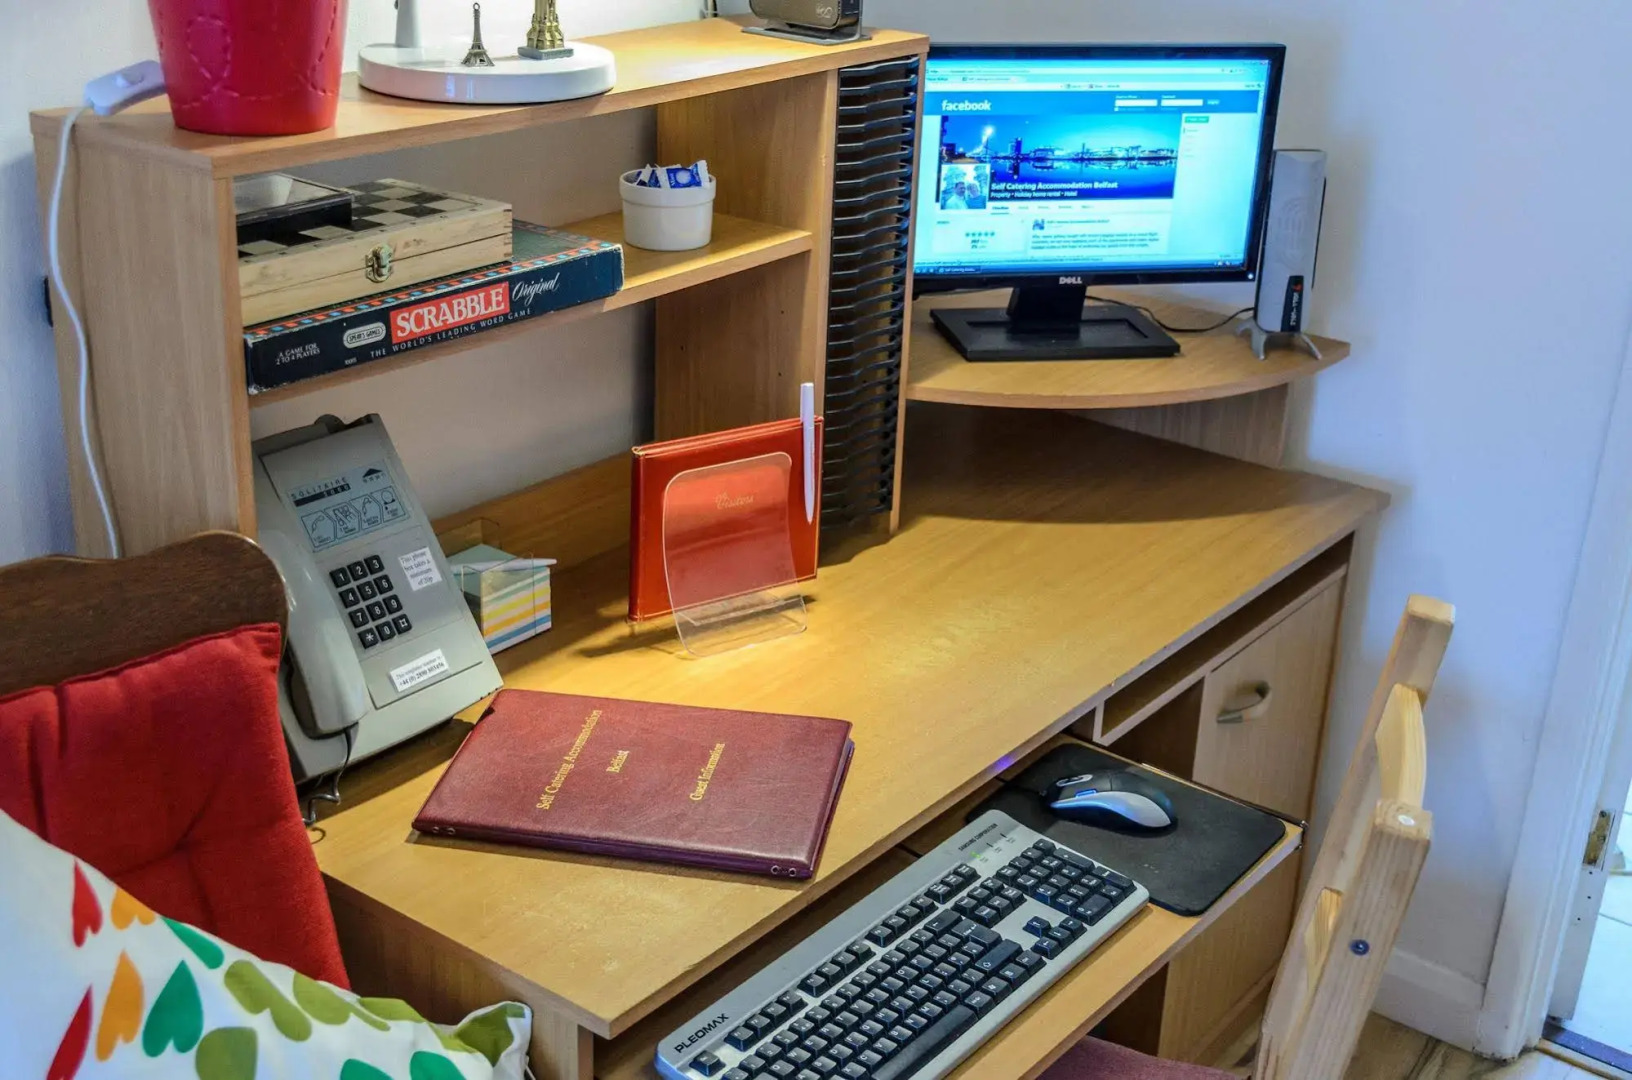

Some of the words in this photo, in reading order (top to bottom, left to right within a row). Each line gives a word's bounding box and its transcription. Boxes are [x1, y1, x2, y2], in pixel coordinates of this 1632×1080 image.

[942, 100, 992, 111] facebook
[1006, 182, 1036, 191] Catering
[1059, 276, 1082, 285] DELL
[512, 272, 560, 306] Original
[397, 288, 504, 337] SCRABBLE
[366, 328, 381, 338] GAMES
[370, 348, 386, 358] THE
[392, 335, 432, 352] WORLD'S
[436, 323, 476, 340] LEADING
[480, 316, 504, 328] WORD
[508, 308, 531, 320] GAME
[286, 346, 303, 357] GAME
[306, 342, 318, 351] FOR
[296, 348, 320, 360] PLAYERS
[373, 560, 380, 569] 3
[356, 566, 362, 575] 2
[340, 573, 345, 581] 1
[382, 580, 388, 588] 6
[348, 592, 354, 601] 4
[391, 600, 398, 608] 9
[374, 606, 380, 615] 8
[356, 613, 362, 621] 7
[384, 626, 390, 634] 0
[563, 710, 602, 763] Accommodation
[545, 760, 574, 794] Catering
[536, 795, 555, 810] Self
[674, 1013, 729, 1053] PLEOMAX
